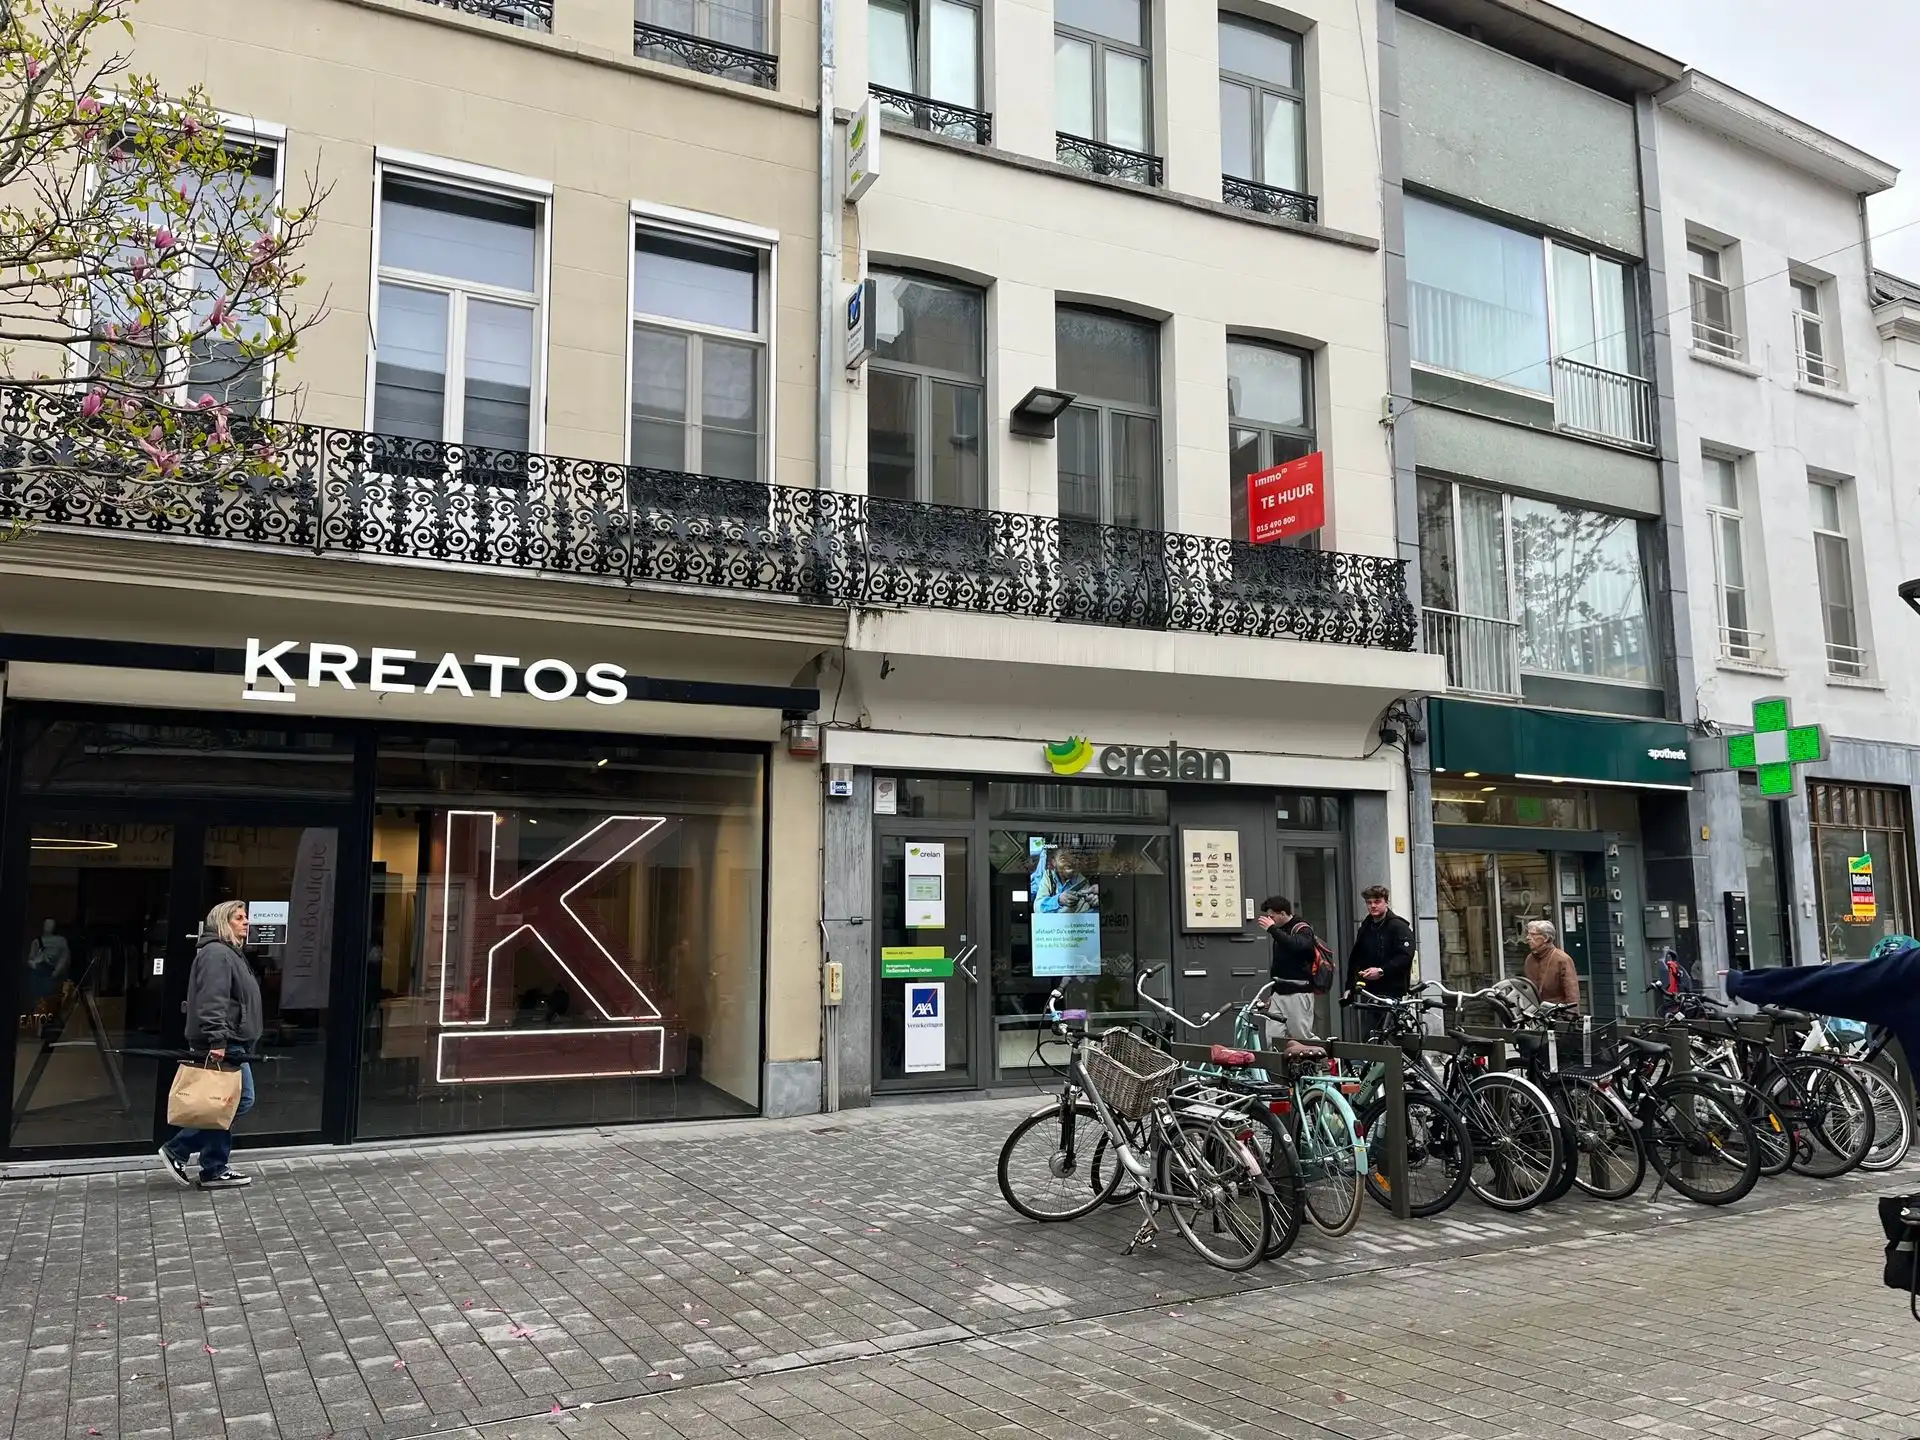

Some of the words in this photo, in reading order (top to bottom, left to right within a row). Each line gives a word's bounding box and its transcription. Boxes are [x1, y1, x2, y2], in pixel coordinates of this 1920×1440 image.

[1261, 495, 1275, 509] TE
[1278, 483, 1314, 504] HUUR
[1256, 523, 1269, 533] 015
[1270, 519, 1282, 529] 490
[1283, 515, 1296, 525] 800
[242, 637, 628, 705] KREATOS
[1100, 740, 1231, 782] crelan
[1647, 748, 1687, 760] apotheek
[301, 842, 332, 928] Boutique
[440, 810, 667, 1025] K
[1608, 844, 1630, 1017] APOTHEEK
[913, 1002, 934, 1016] AXA
